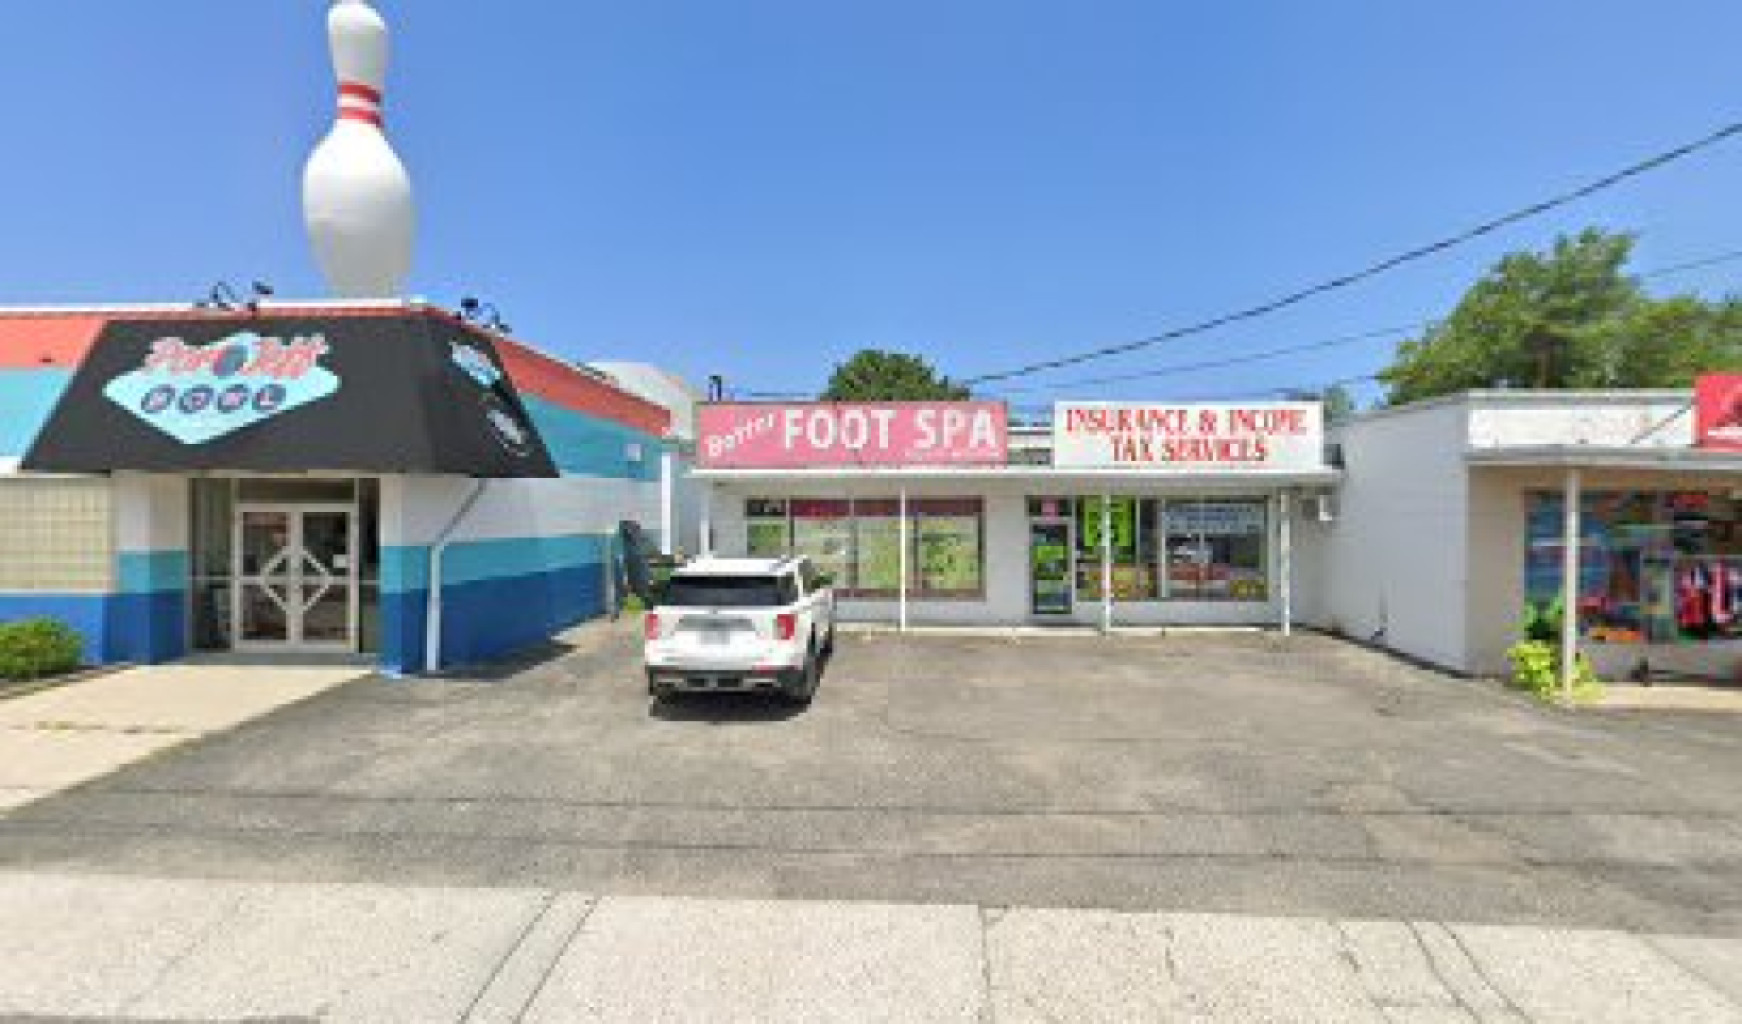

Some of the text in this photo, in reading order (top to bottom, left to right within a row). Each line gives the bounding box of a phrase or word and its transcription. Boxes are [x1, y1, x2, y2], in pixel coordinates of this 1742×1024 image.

[144, 385, 284, 413] BOWL
[785, 408, 896, 449] FOOT
[914, 408, 999, 449] SPA
[1199, 409, 1217, 434] &
[1228, 409, 1307, 434] INCOME
[1110, 438, 1267, 462] TAX SERVICES
